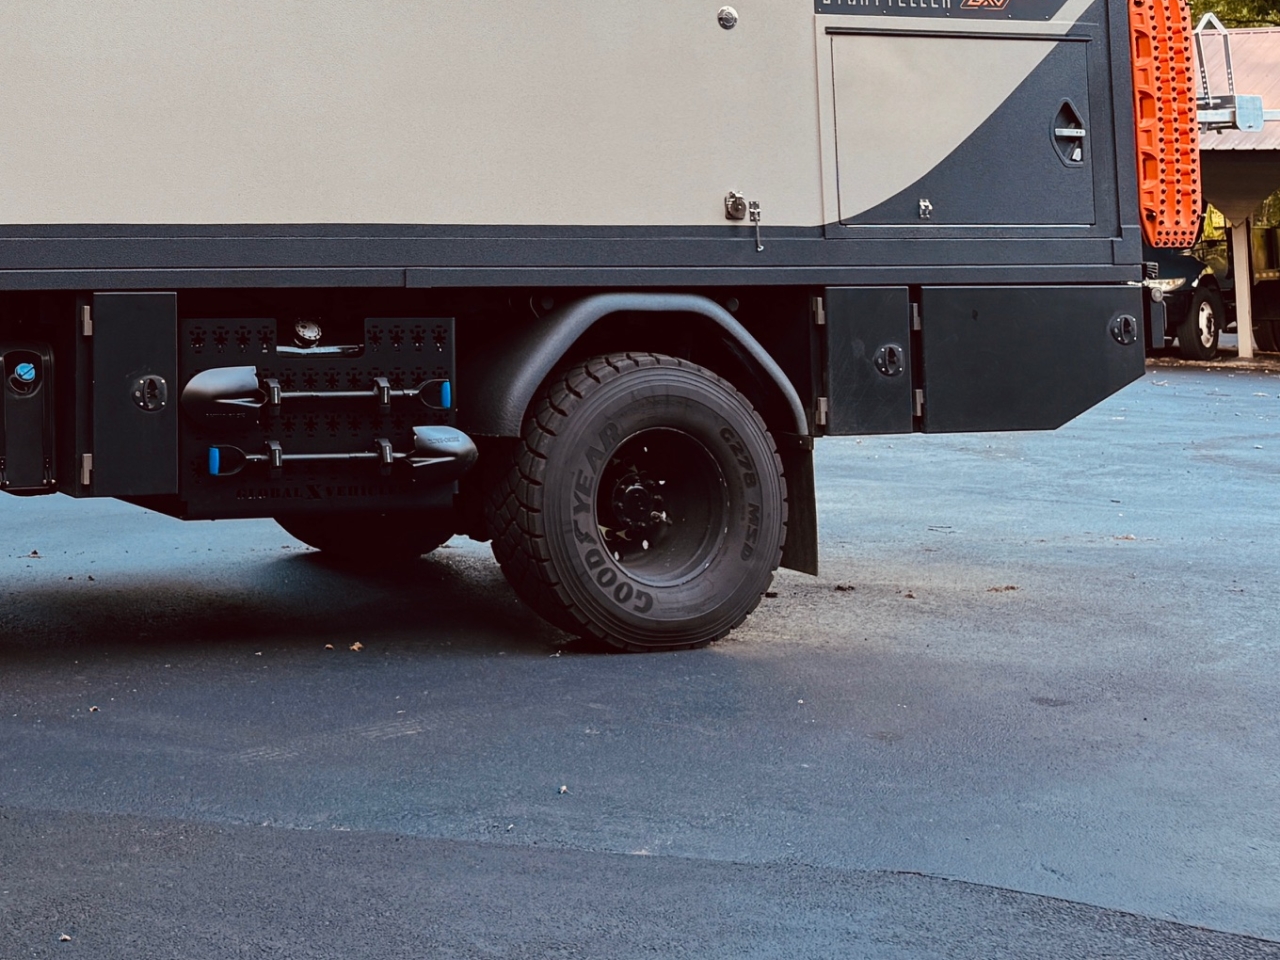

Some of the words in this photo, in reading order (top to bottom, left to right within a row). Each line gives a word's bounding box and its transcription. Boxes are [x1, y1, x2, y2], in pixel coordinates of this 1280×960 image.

[236, 487, 302, 499] GLOBAL
[719, 427, 759, 488] G278
[741, 503, 761, 562] MSD
